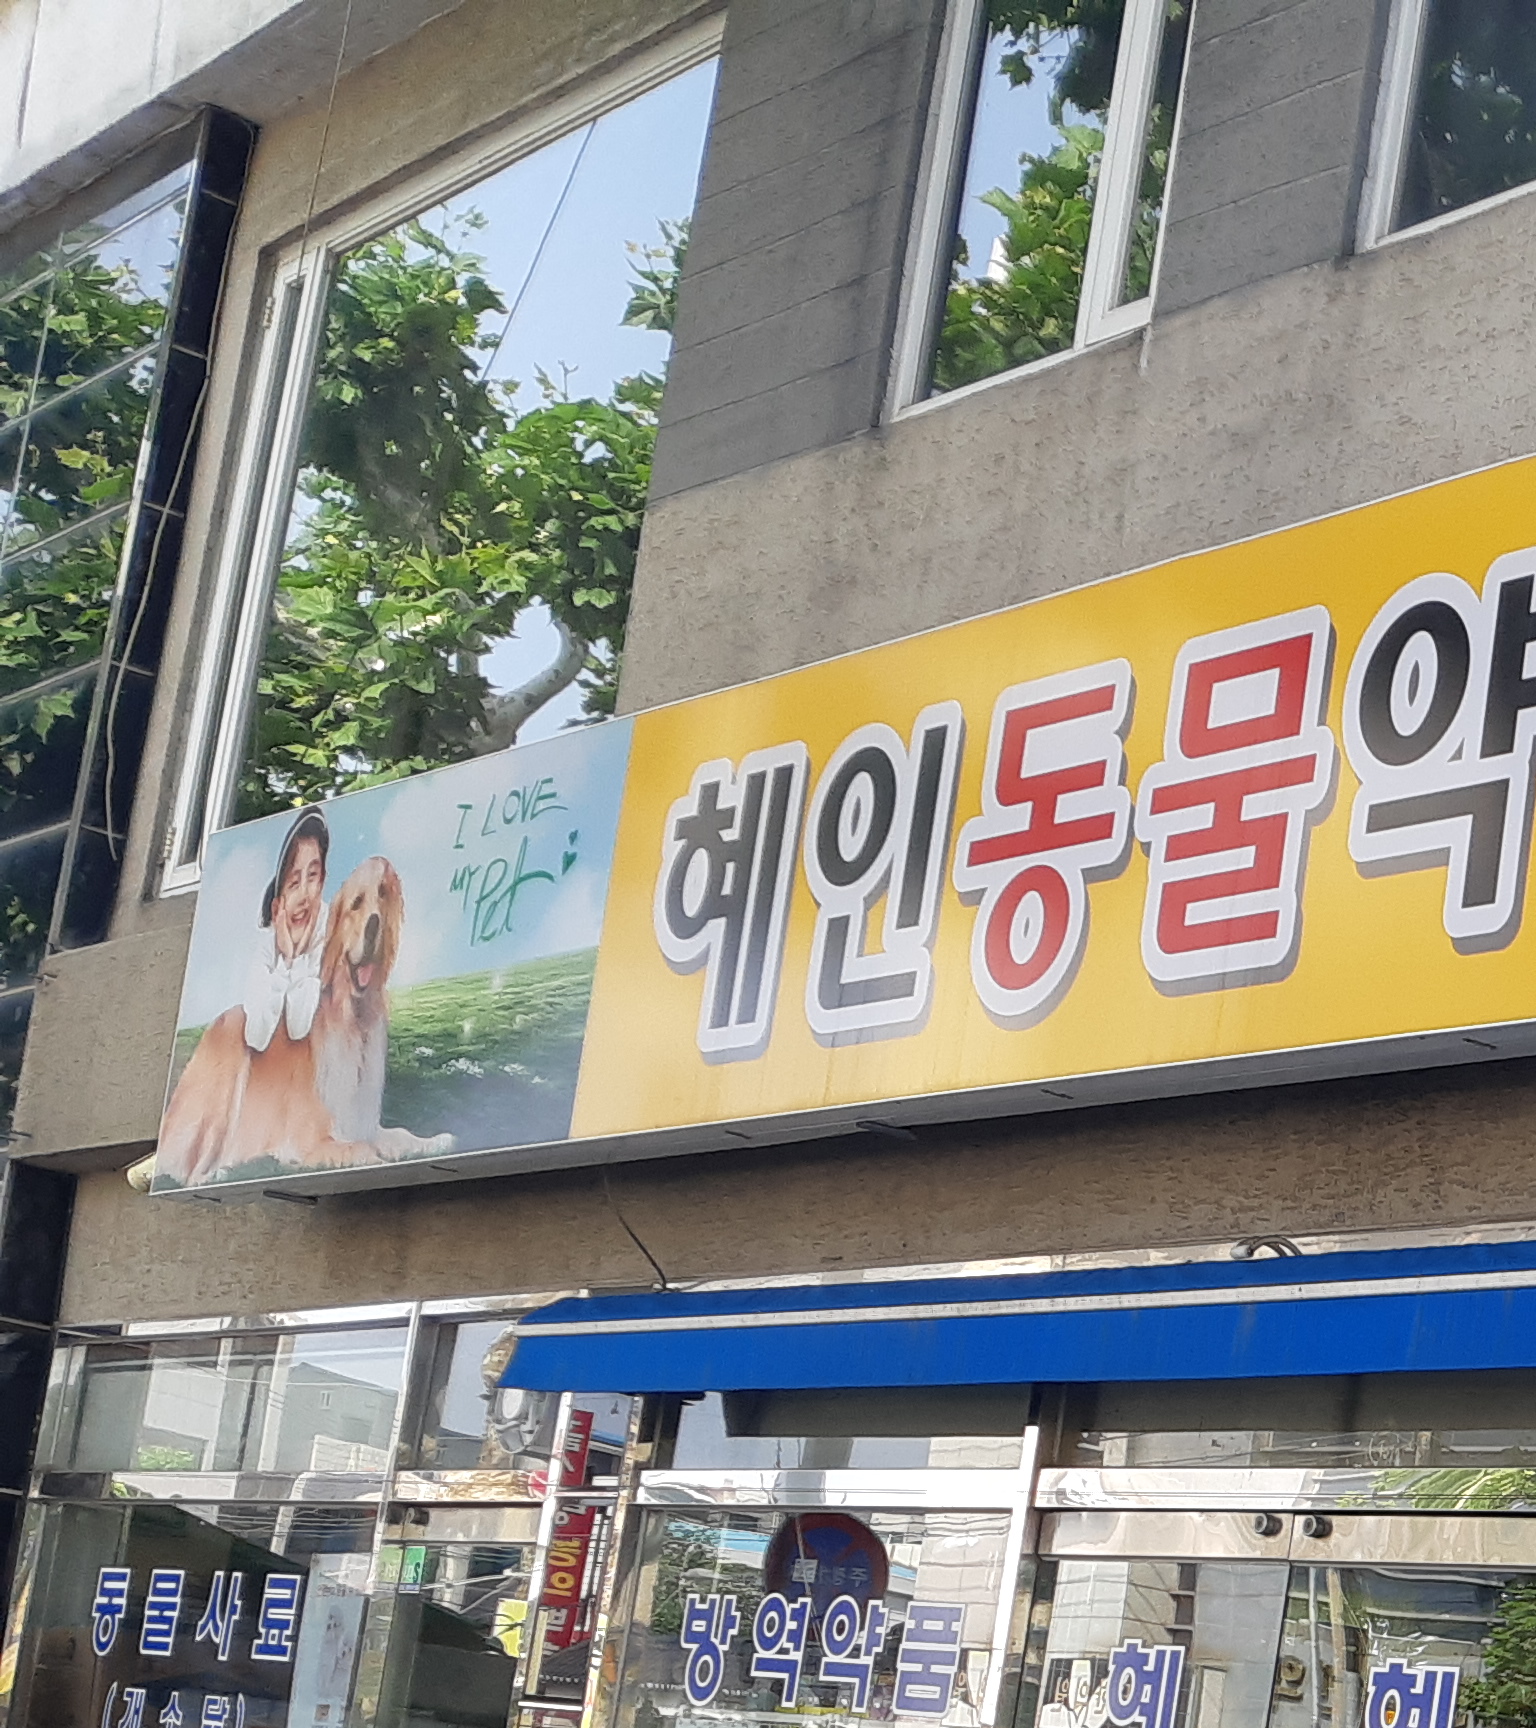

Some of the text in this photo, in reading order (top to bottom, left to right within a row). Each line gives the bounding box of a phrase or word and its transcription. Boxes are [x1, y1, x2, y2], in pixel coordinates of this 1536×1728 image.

[453, 777, 569, 849] I LOVE
[92, 1567, 302, 1662] 동물사료
[678, 1592, 965, 1718] 방역약품
